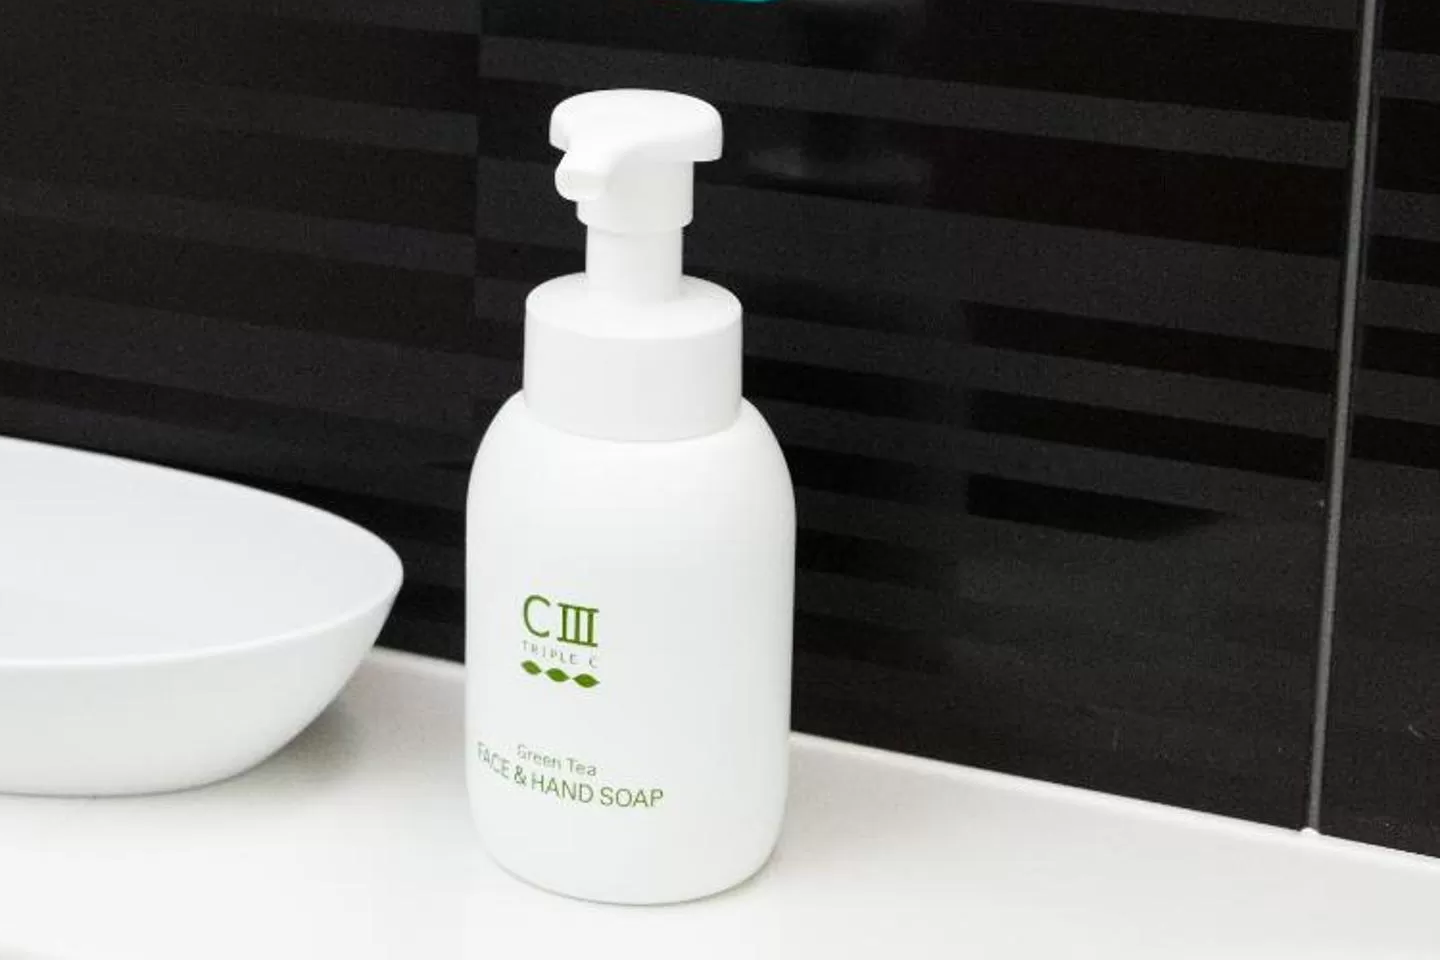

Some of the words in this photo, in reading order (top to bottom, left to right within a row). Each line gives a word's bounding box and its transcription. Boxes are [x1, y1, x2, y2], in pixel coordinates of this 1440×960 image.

[522, 639, 579, 665] TRIPLE
[517, 743, 562, 771] Green
[565, 757, 598, 777] Tea
[513, 764, 528, 787] &
[530, 771, 595, 804] HAND
[598, 786, 665, 808] SOAP
